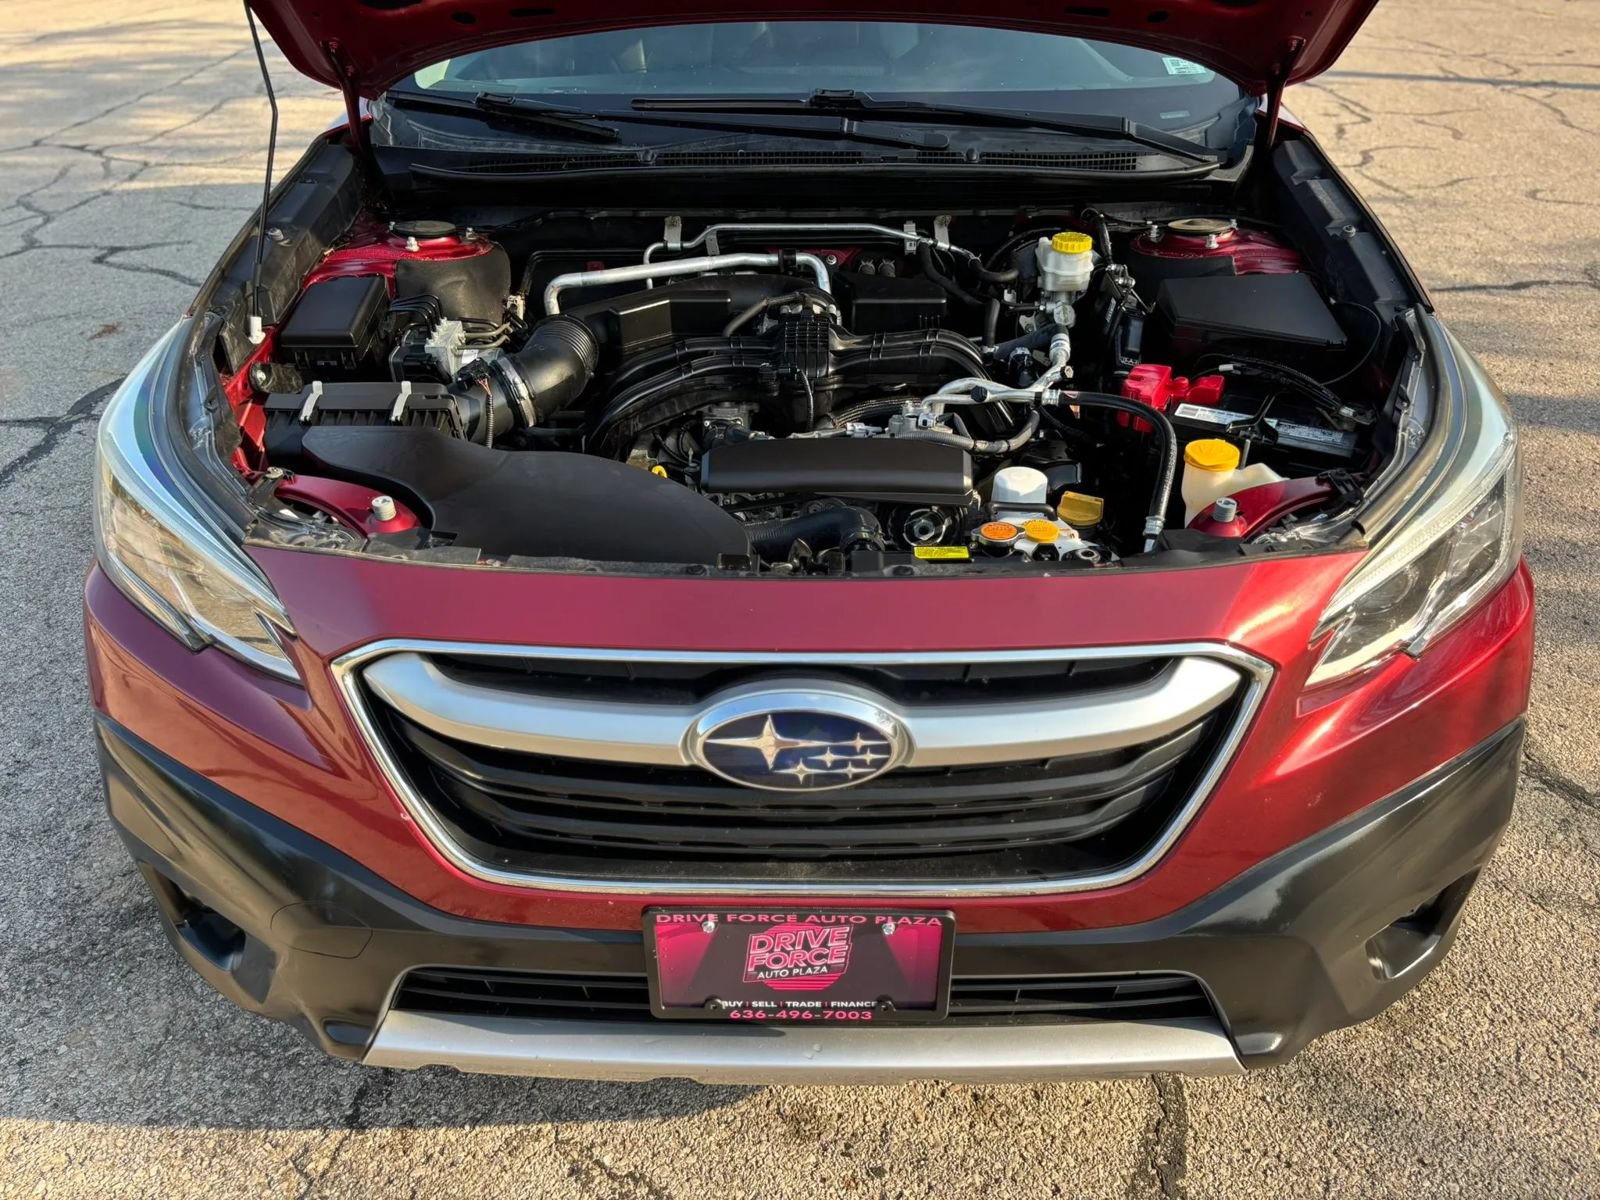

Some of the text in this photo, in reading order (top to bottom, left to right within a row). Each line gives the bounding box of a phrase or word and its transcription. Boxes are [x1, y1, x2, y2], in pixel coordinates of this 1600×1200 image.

[655, 913, 943, 926] DRIVE FORCE AUTO PLAZA
[751, 926, 850, 954] DRIVE
[747, 945, 849, 972] FORCE
[757, 965, 829, 980] AUTO PLAZA
[724, 1000, 743, 1009] BUY
[751, 1000, 777, 1008] SELL
[785, 1000, 822, 1008] TRADE
[729, 1010, 873, 1020] 636-496-7003
